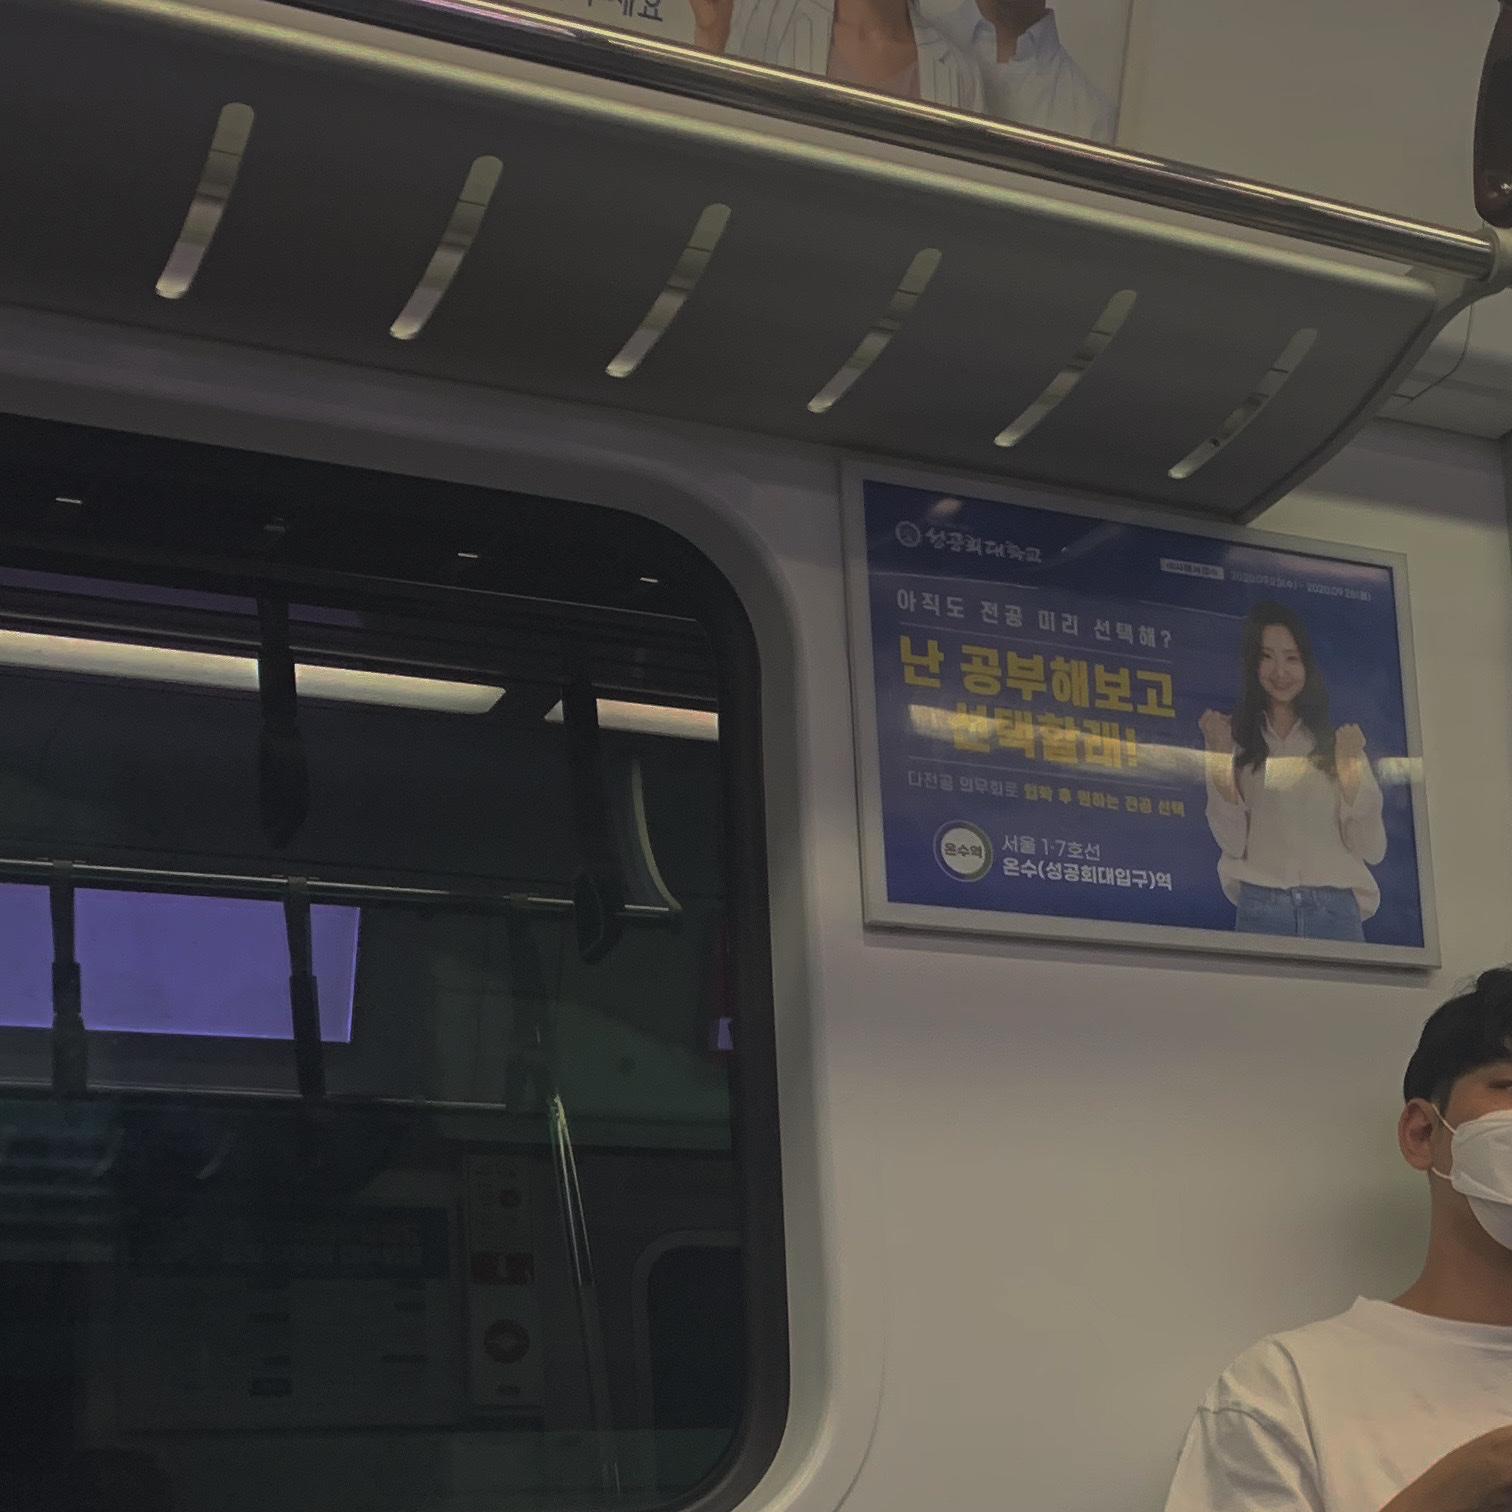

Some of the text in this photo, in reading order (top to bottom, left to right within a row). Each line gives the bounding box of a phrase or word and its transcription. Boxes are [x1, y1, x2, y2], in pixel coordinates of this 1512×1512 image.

[897, 588, 1172, 648] 아직도 전공 미리 선택해?
[899, 635, 1176, 719] 난 공부해보고
[949, 702, 1138, 770] 선택할래!
[943, 841, 983, 860] 온수역
[1002, 834, 1036, 856] 서울
[1002, 857, 1173, 891] 온수(성공회대입구)역
